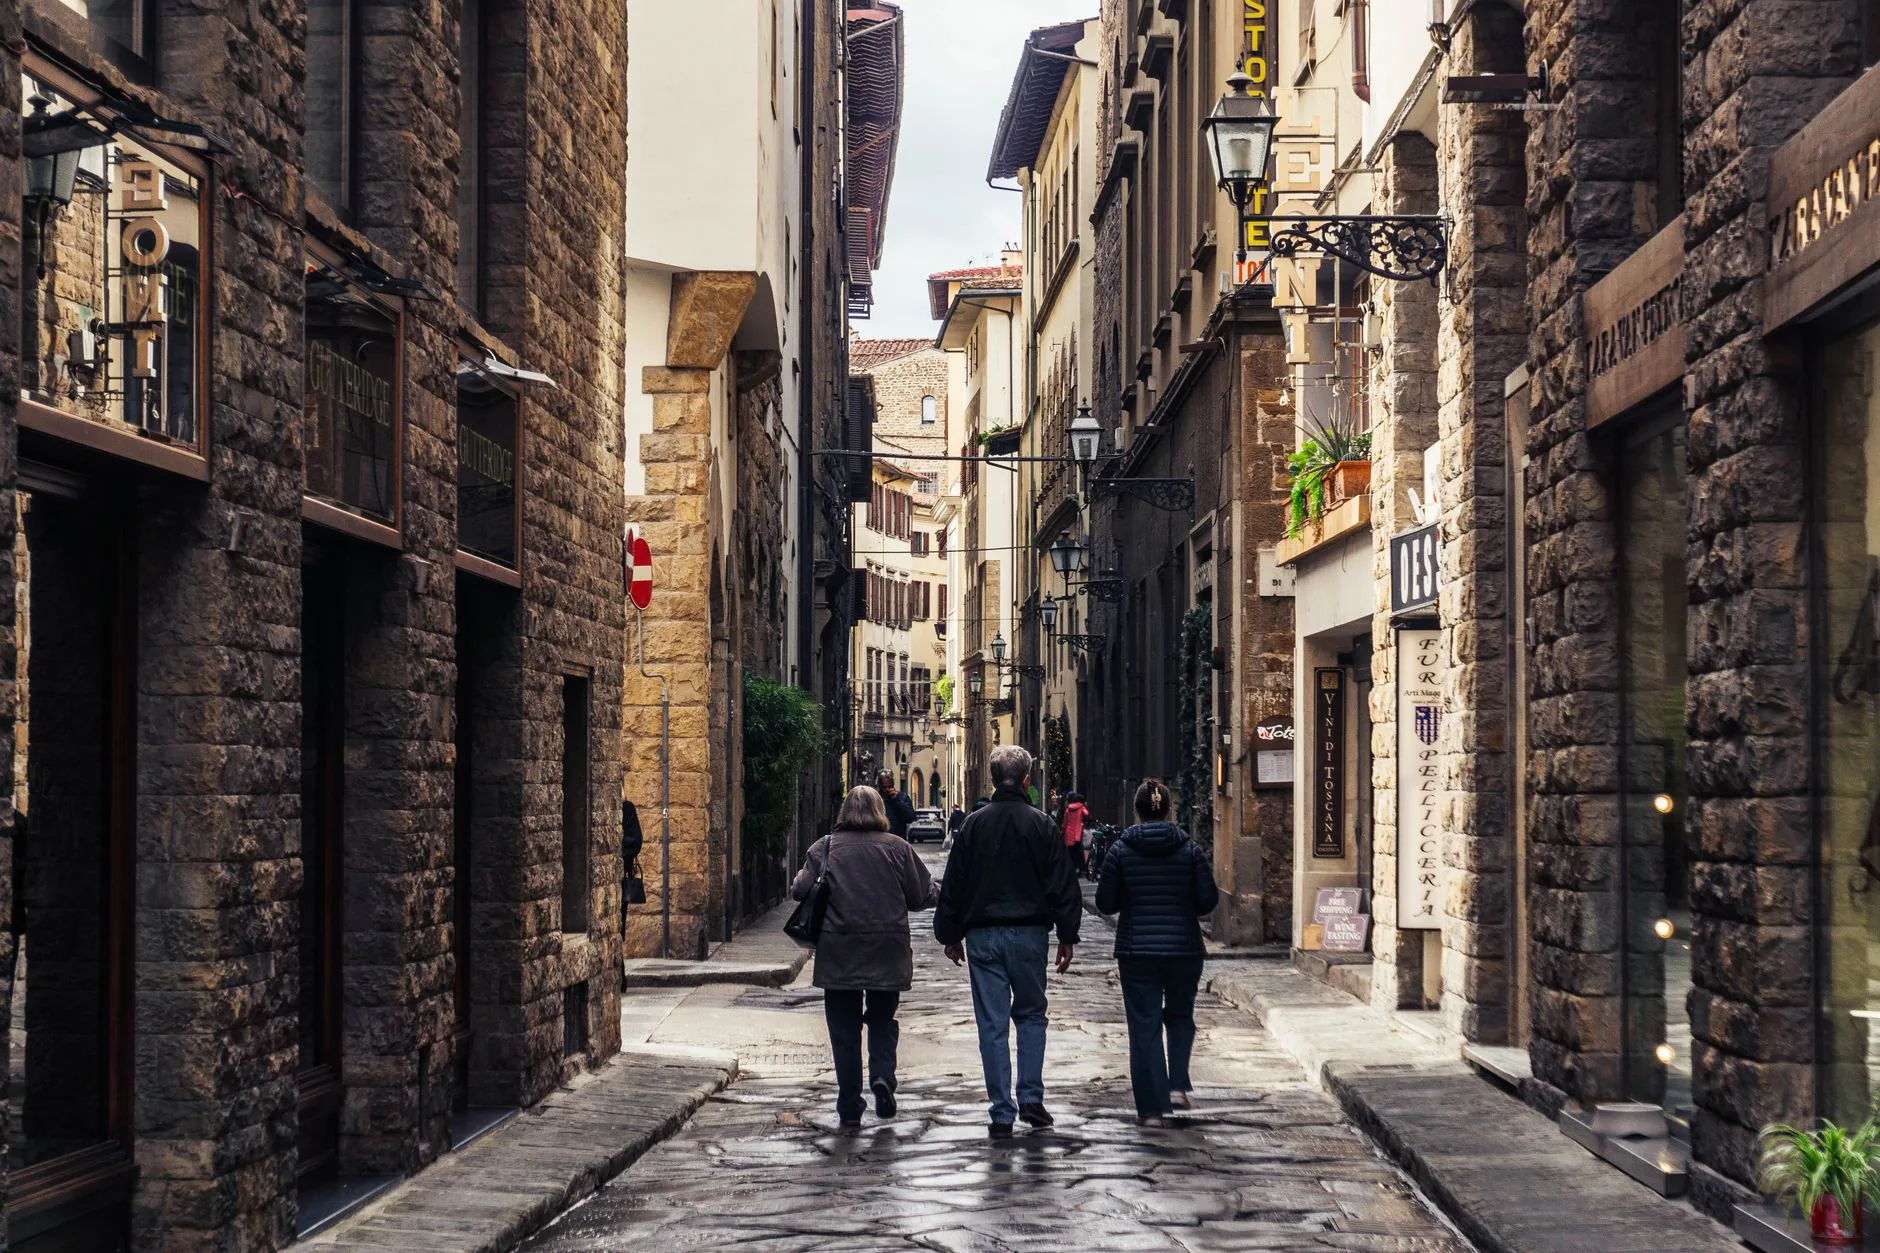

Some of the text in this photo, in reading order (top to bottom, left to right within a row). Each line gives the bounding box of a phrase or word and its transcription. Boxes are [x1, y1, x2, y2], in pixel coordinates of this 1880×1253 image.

[1269, 86, 1322, 364] LEONI
[310, 339, 390, 427] GUTTERIDGE
[459, 423, 513, 489] GUTTERIDGE
[1417, 638, 1441, 685] FUR
[1323, 692, 1336, 843] VINI DI TOSCANA
[1413, 749, 1441, 917] PELLICCERIA
[1327, 931, 1362, 940] TASTING
[1334, 922, 1357, 932] WINE
